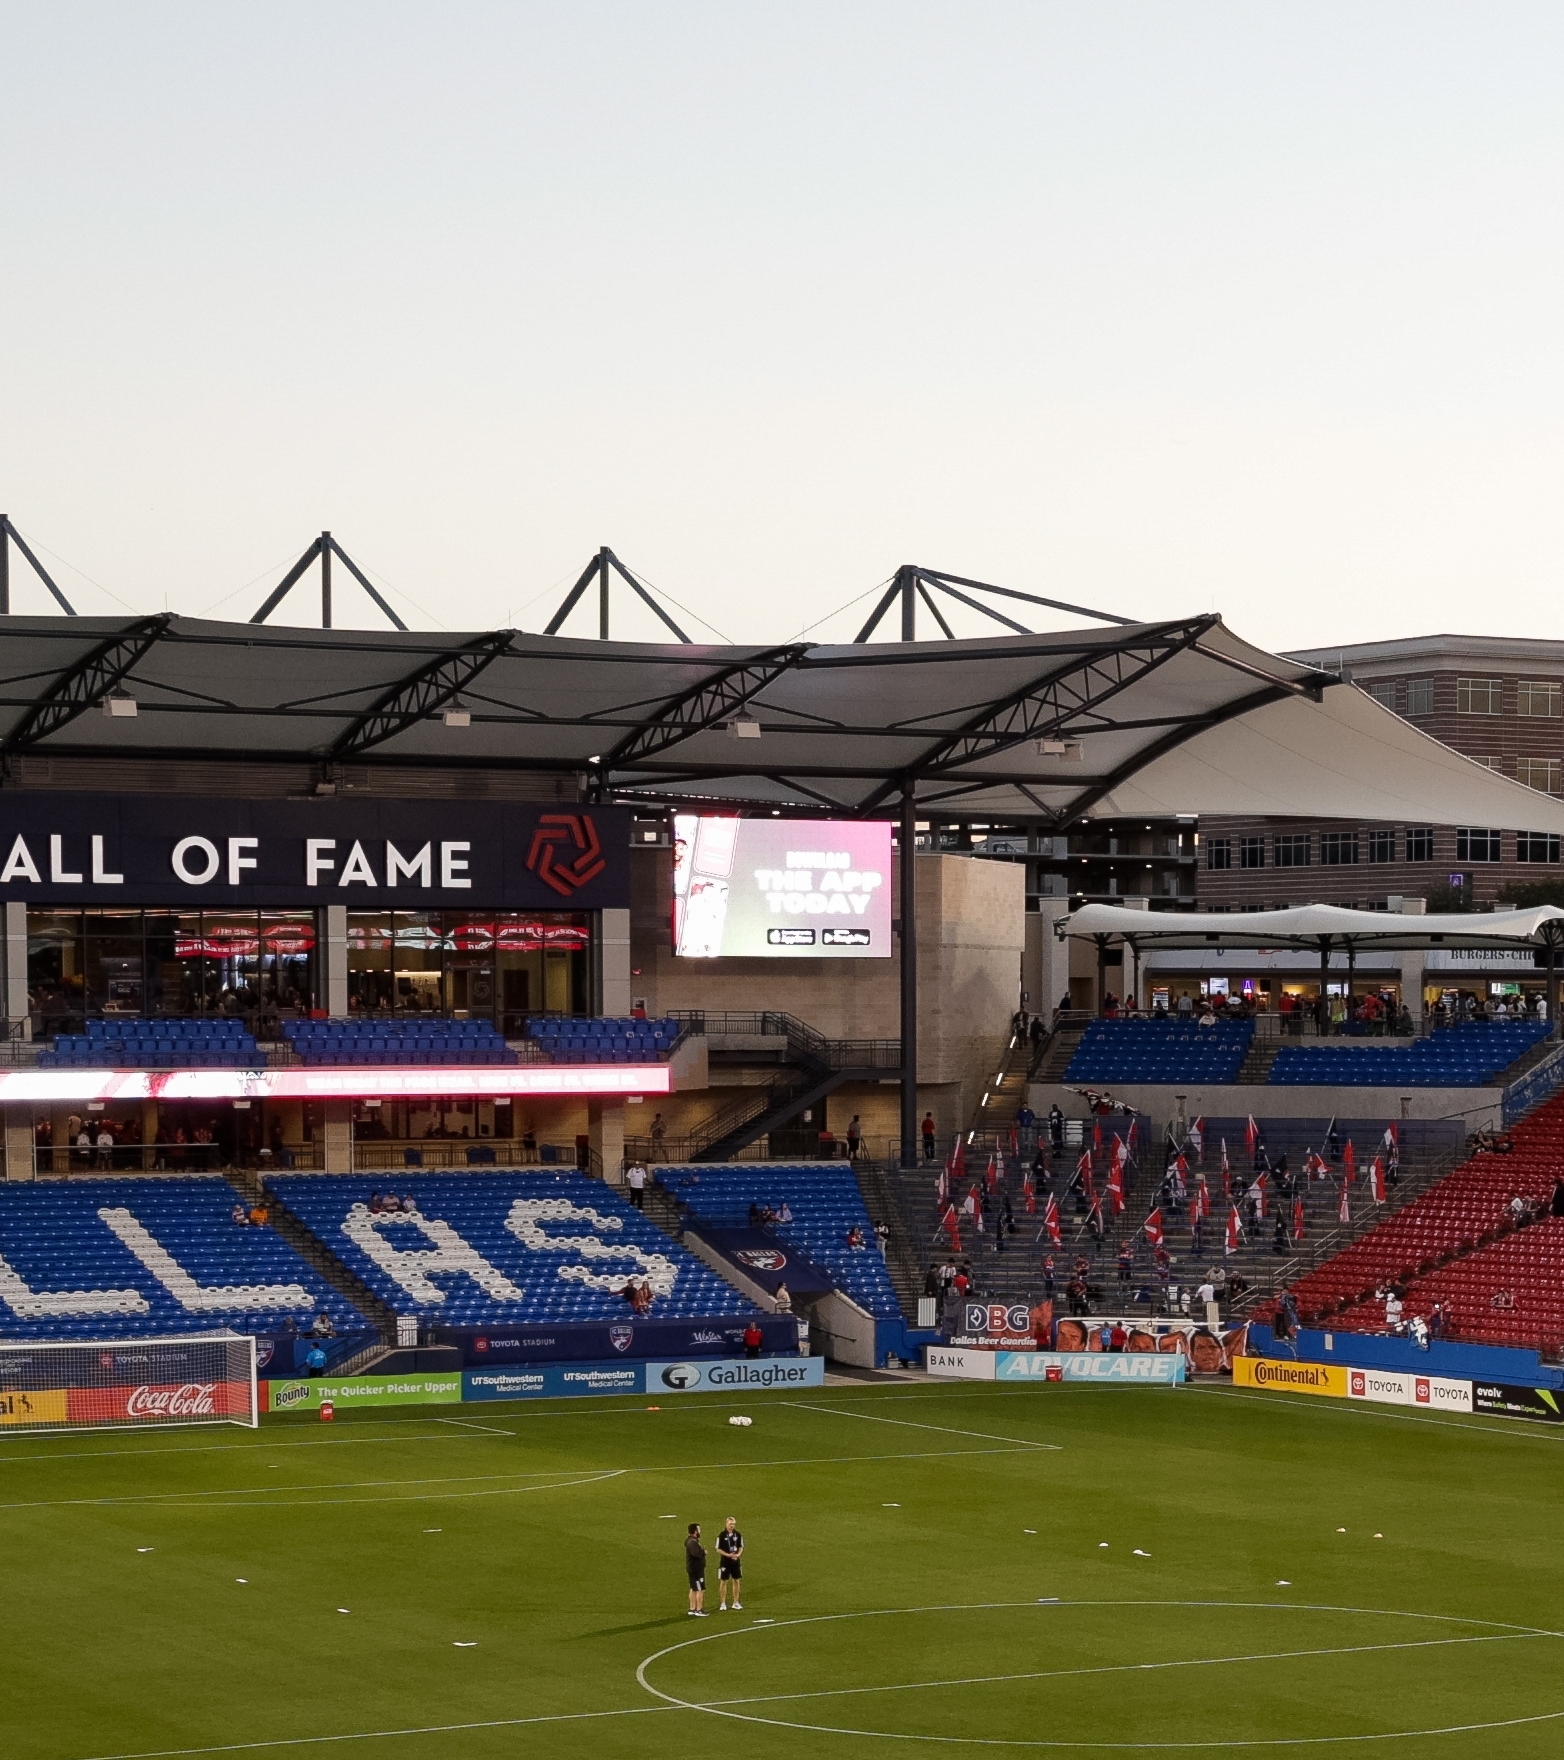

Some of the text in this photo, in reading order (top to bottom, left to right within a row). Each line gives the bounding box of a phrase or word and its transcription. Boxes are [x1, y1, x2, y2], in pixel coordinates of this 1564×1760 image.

[171, 836, 258, 886] OF
[306, 837, 472, 888] FAME
[754, 869, 882, 892] THE APP
[766, 892, 871, 914] TODAY
[1451, 950, 1505, 960] BURGERS
[966, 1304, 1030, 1332] DBG
[490, 1338, 555, 1348] TOYOTA STADIUM
[950, 1336, 1037, 1346] Dallas Beer Guardia
[116, 1355, 149, 1363] TOYOTA
[930, 1355, 964, 1368] BANK
[1006, 1356, 1173, 1377] ADVOCARE
[1254, 1361, 1320, 1385] Continental
[708, 1364, 807, 1387] Gallagher
[317, 1382, 458, 1397] The Quicker Picker Upper
[497, 1383, 543, 1392] Medical Center
[588, 1379, 635, 1388] Medical Center
[1368, 1380, 1403, 1393] TOYOTA
[127, 1383, 217, 1416] Coca-Cola
[276, 1385, 310, 1407] Bounty
[1433, 1387, 1469, 1401] TOYOTA
[1477, 1387, 1502, 1398] evolv
